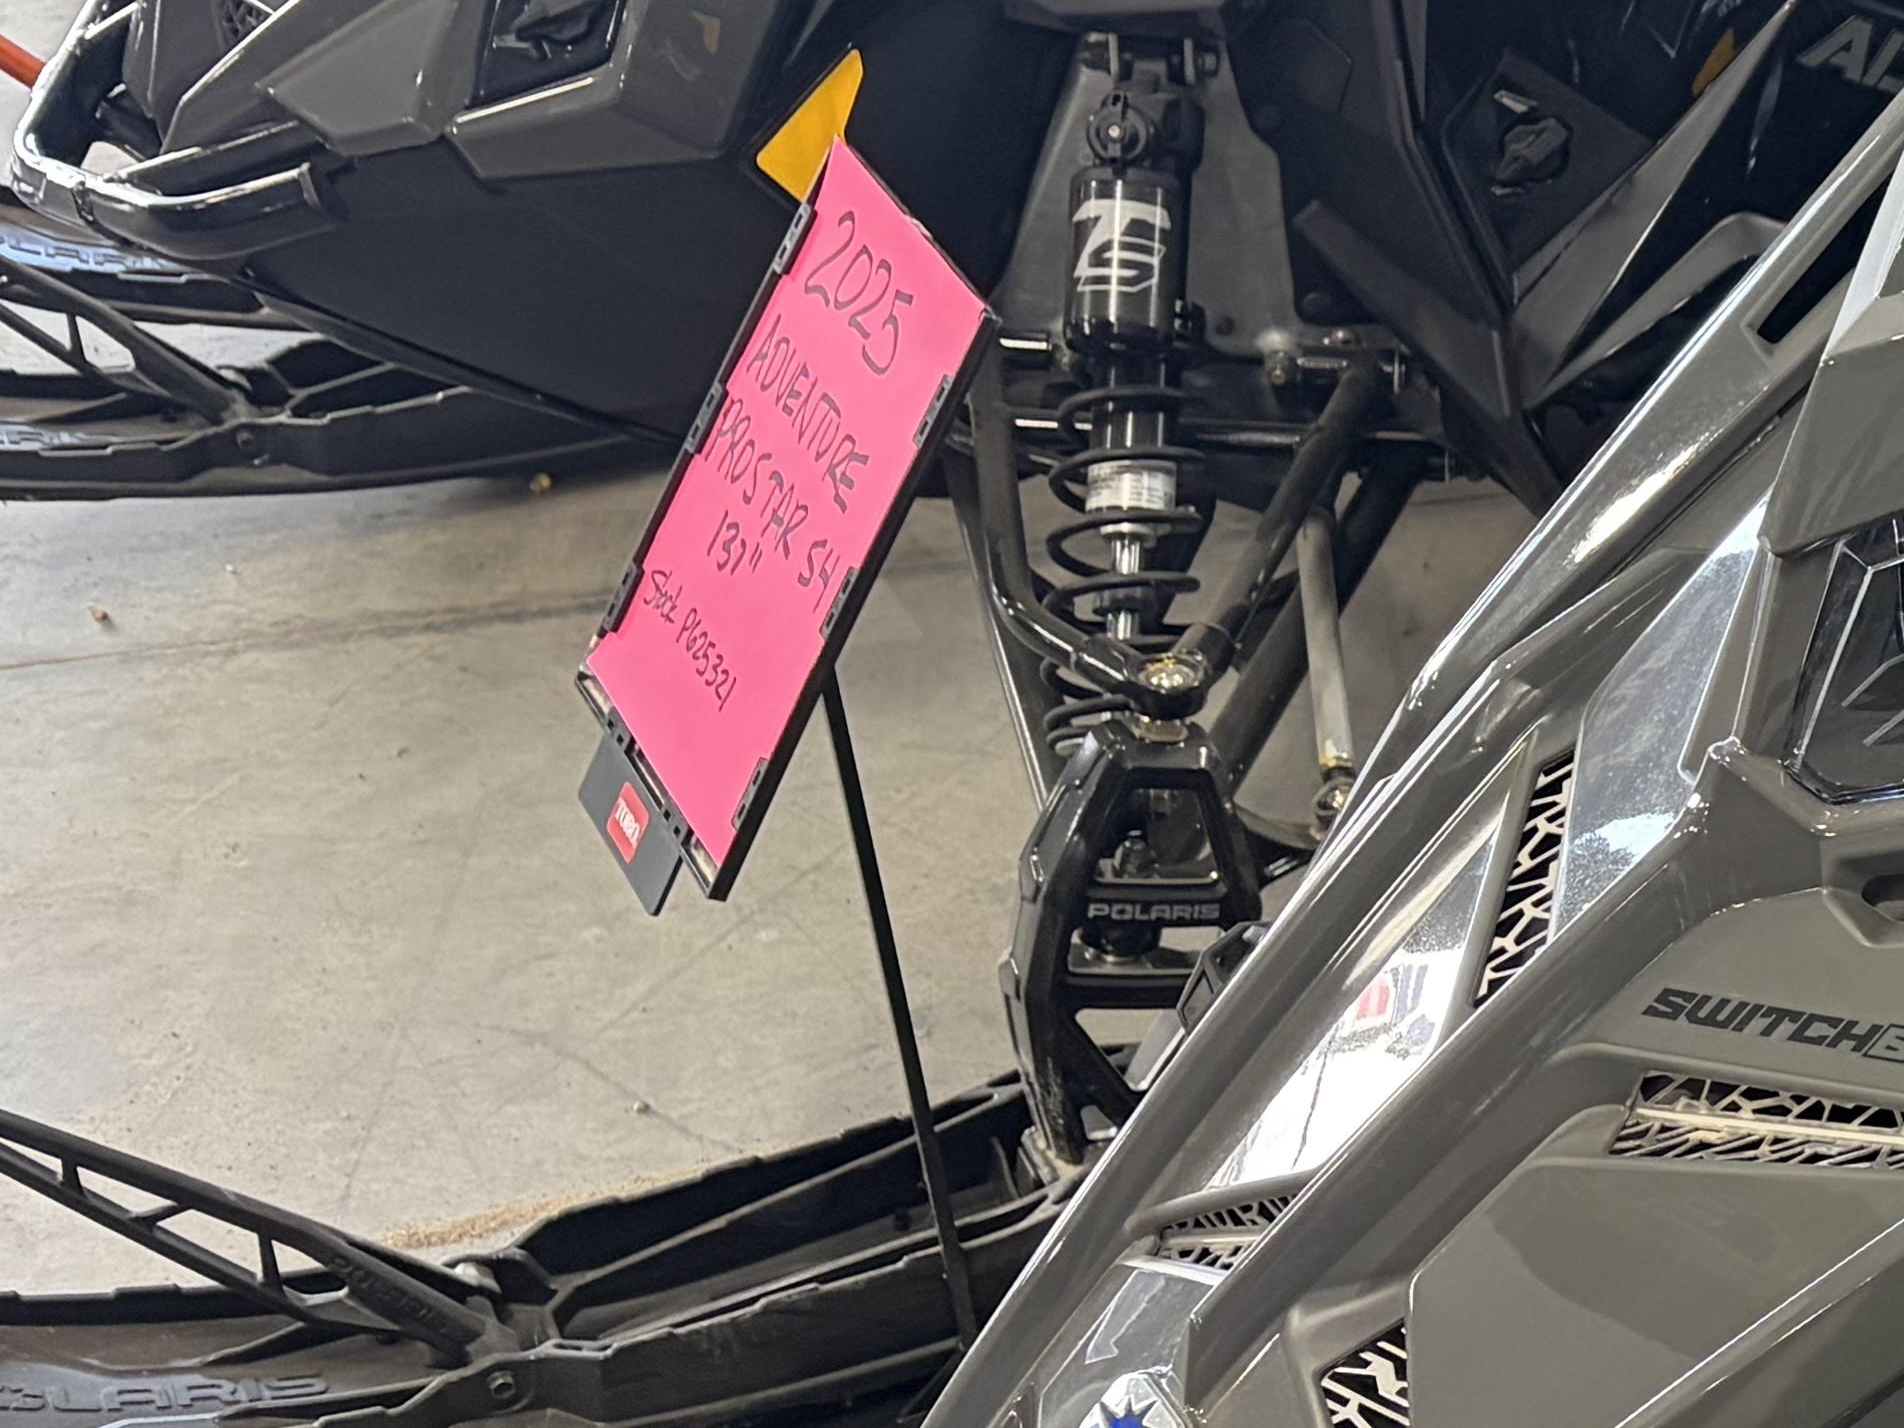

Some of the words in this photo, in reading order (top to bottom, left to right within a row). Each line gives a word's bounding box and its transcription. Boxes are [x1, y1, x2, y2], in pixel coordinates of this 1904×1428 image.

[803, 209, 915, 377] 2025
[745, 313, 870, 514] ADVENTURE
[1087, 901, 1222, 923] POLARIS
